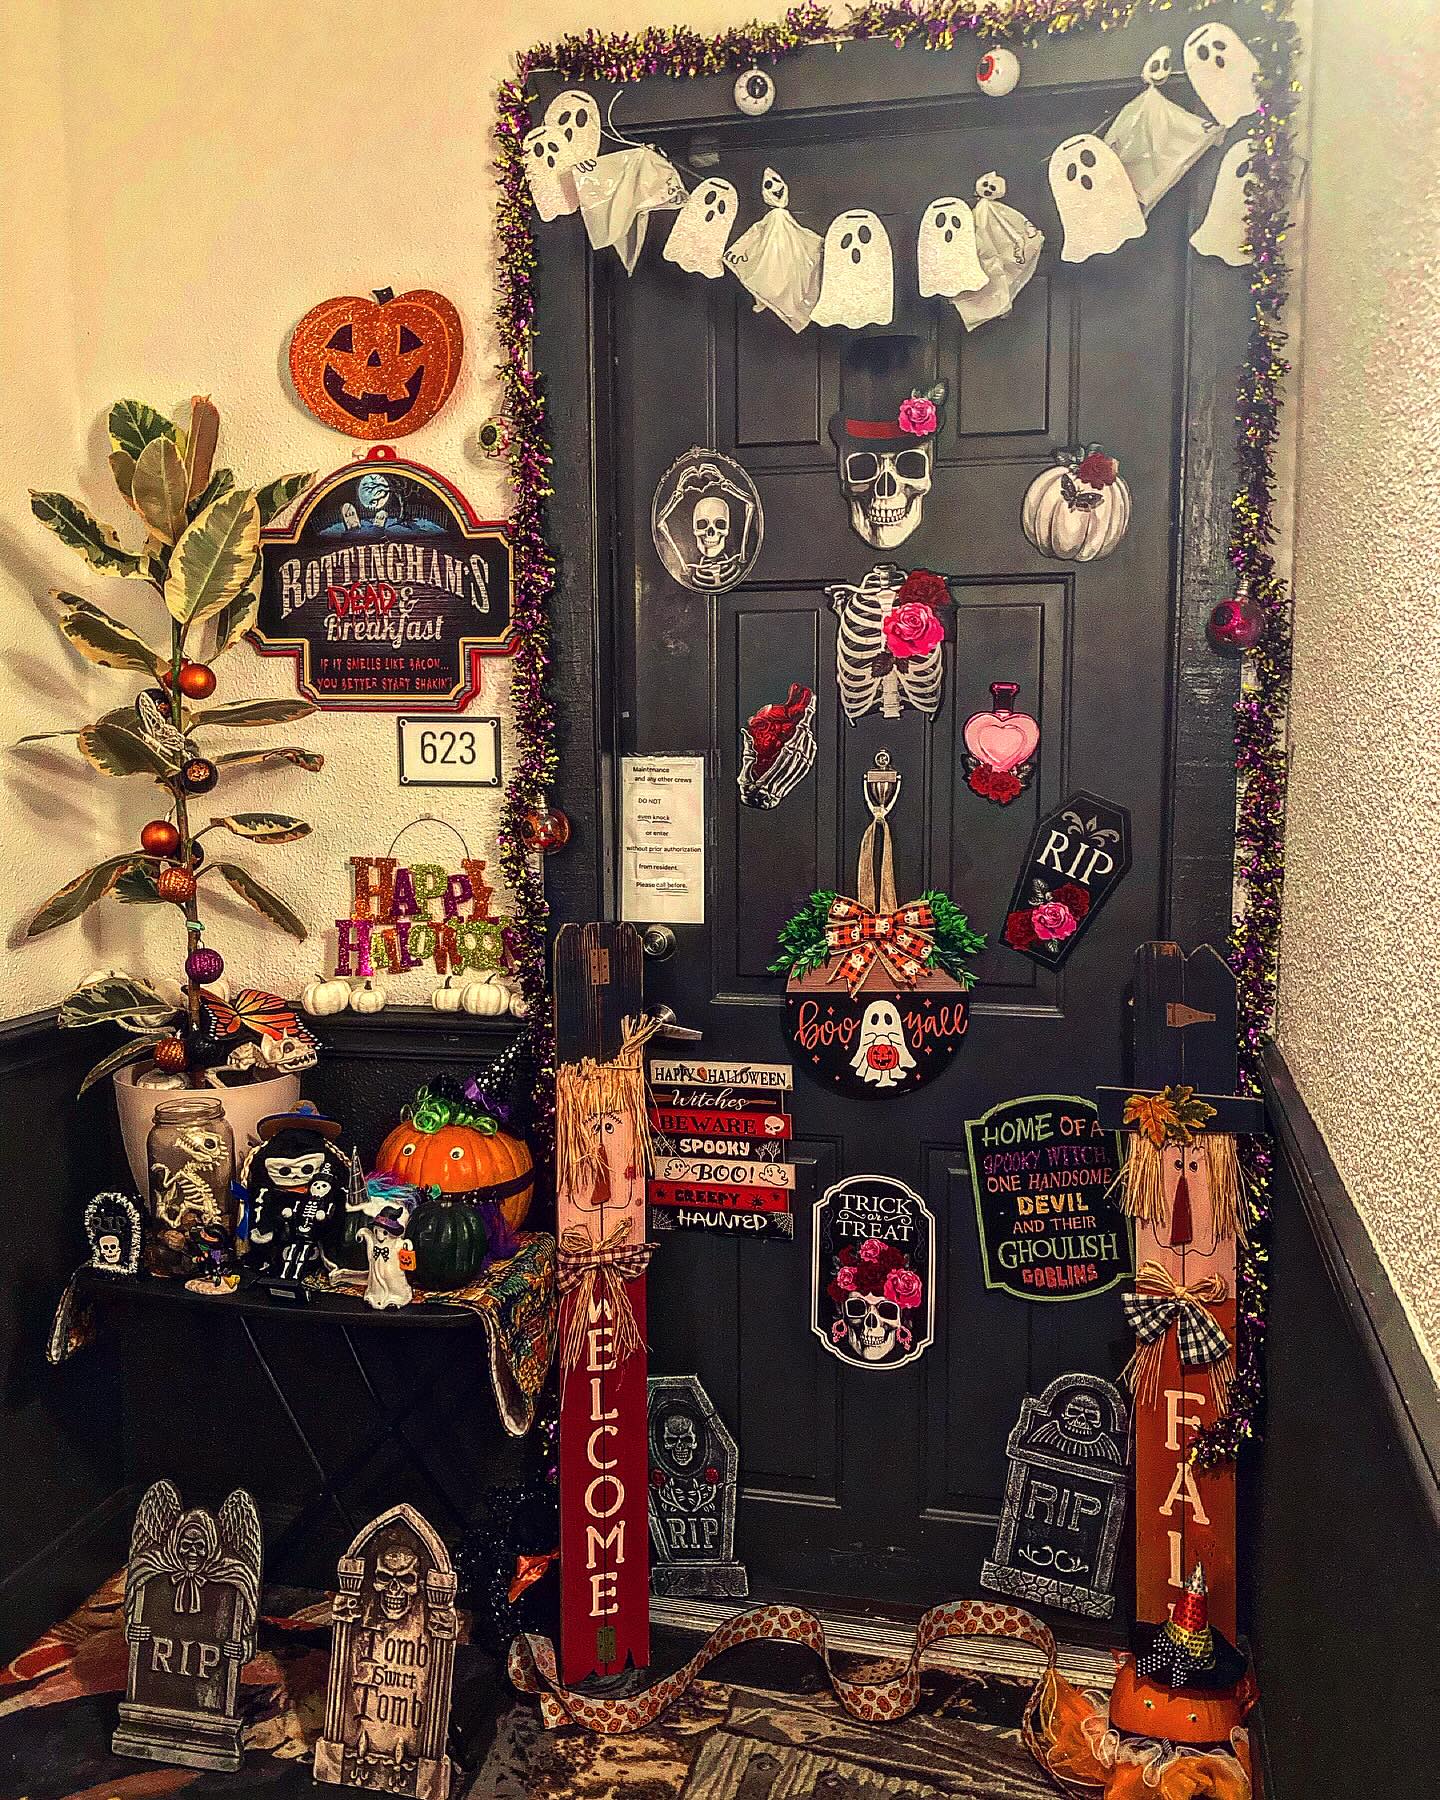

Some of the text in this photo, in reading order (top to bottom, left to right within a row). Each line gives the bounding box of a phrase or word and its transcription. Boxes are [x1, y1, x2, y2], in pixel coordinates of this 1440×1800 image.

[279, 543, 490, 619] ROTTINGHAM'S
[327, 581, 419, 617] DEAD &
[324, 612, 444, 649] Breakfast
[320, 657, 328, 672] IF
[333, 657, 342, 670] IT
[347, 657, 381, 670] SMELLS
[385, 657, 404, 670] LIKE
[319, 678, 337, 689] YOU
[341, 678, 377, 690] BETTER
[381, 678, 411, 690] START
[420, 731, 477, 765] 623
[1036, 830, 1114, 885] RIP
[350, 856, 499, 926] HAPPY
[794, 1000, 860, 1050] boo
[655, 1065, 786, 1087] HAPPY HALLOWEEN
[672, 1087, 748, 1111] Witches
[660, 1115, 757, 1135] BEWARE
[981, 1112, 1105, 1147] HOME OF A
[679, 1138, 750, 1156] SPOOKY
[691, 1163, 755, 1184] BOO!
[983, 1149, 1041, 1175] SPOOKY
[986, 1167, 1114, 1194] ONE HANDSOME
[674, 1188, 741, 1207] CREEPY
[838, 1193, 913, 1216] TRICK
[1016, 1192, 1089, 1216] DEVIL
[677, 1209, 768, 1231] HAUNTED
[836, 1219, 914, 1241] TREAT
[867, 1212, 882, 1222] or
[1013, 1215, 1097, 1234] AND THEIR
[998, 1233, 1120, 1269] GHOULISH
[1022, 1263, 1099, 1289] GOBLINS
[1024, 1479, 1102, 1532] RIP
[666, 1518, 719, 1549] RIP
[151, 1636, 220, 1679] RIP
[358, 1626, 430, 1669] Tomb
[352, 1680, 424, 1730] Tomb
